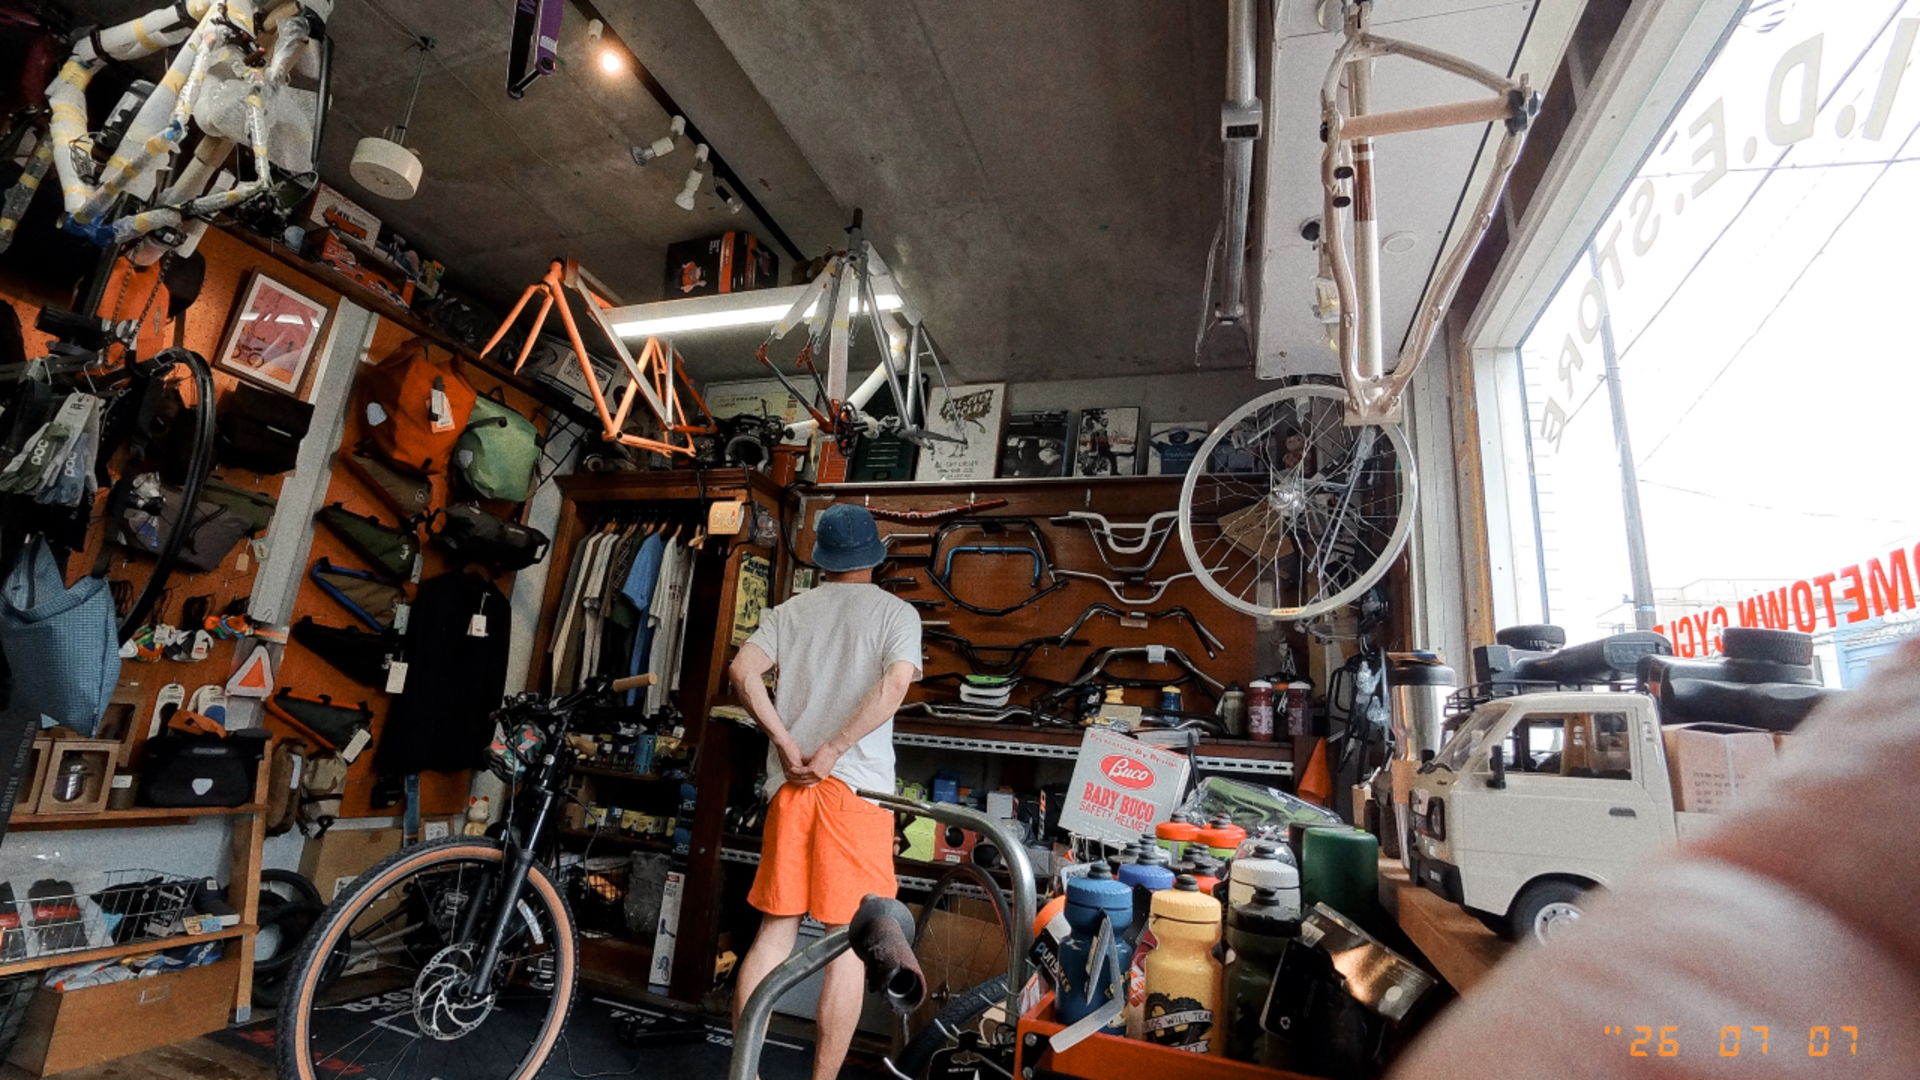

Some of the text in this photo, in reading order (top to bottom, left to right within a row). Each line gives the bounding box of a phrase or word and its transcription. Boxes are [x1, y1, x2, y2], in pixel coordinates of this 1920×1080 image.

[1108, 758, 1149, 781] Buco
[1079, 800, 1113, 819] SAFETY
[1114, 813, 1150, 834] HELMET
[1083, 781, 1155, 823] BABY BUCO
